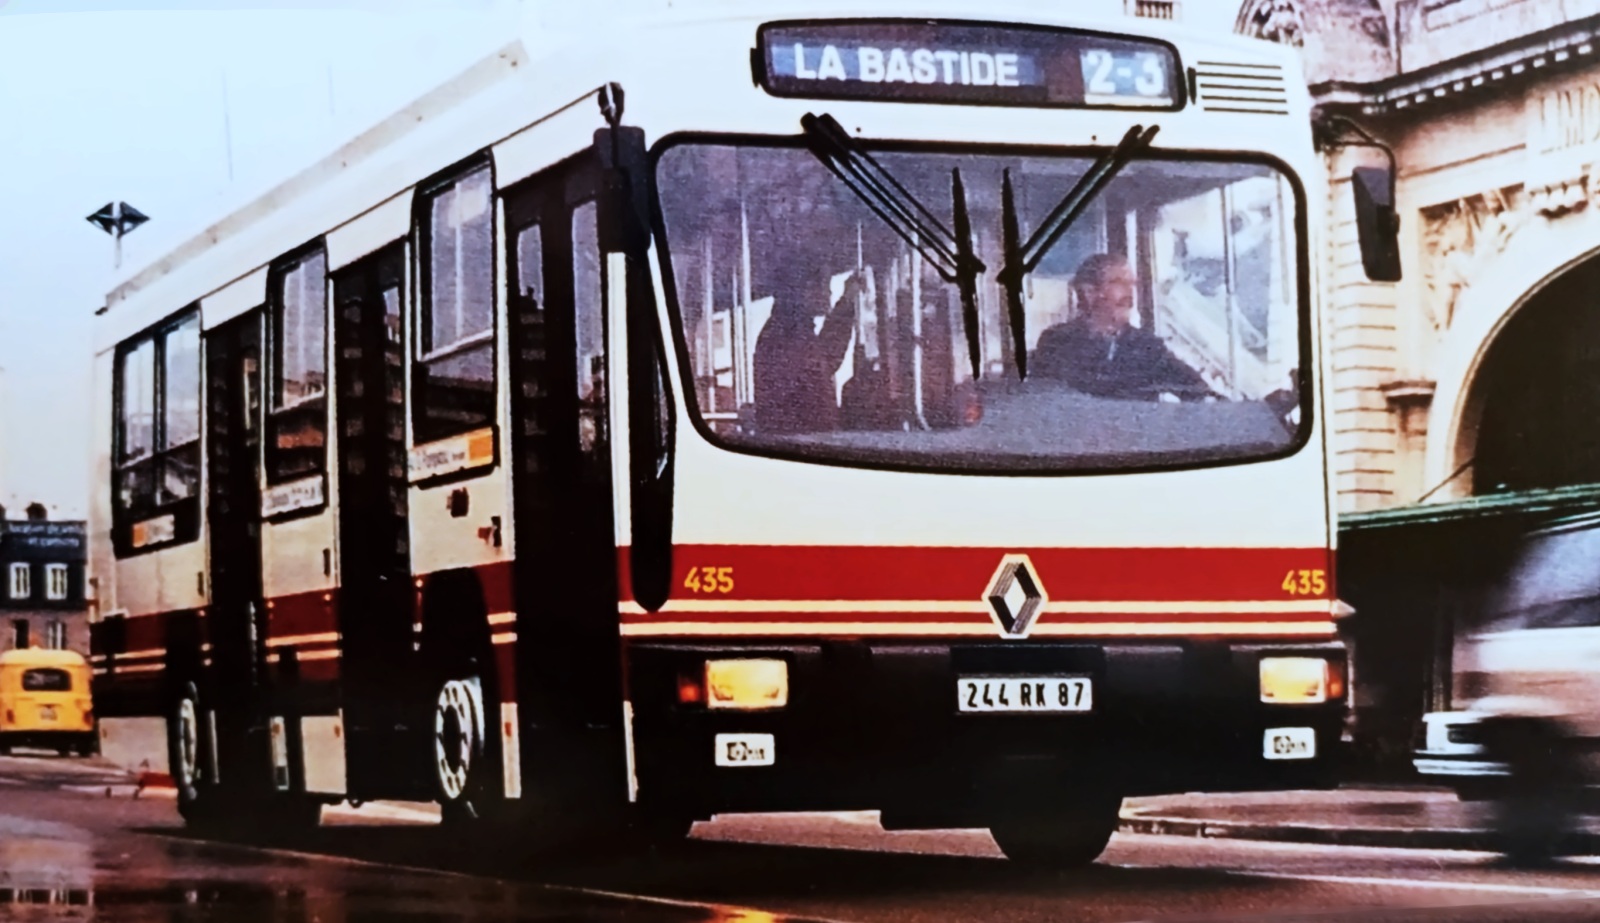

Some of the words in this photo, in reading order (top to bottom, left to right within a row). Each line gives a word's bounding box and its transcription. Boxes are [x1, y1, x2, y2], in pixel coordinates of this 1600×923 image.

[795, 42, 846, 81] LA
[858, 47, 1019, 86] BASTIDE
[1087, 49, 1164, 96] 2-3
[684, 566, 734, 593] 435
[1281, 569, 1326, 595] 435
[967, 682, 1009, 708] 244
[1020, 683, 1046, 707] RK
[1058, 682, 1084, 707] 87
